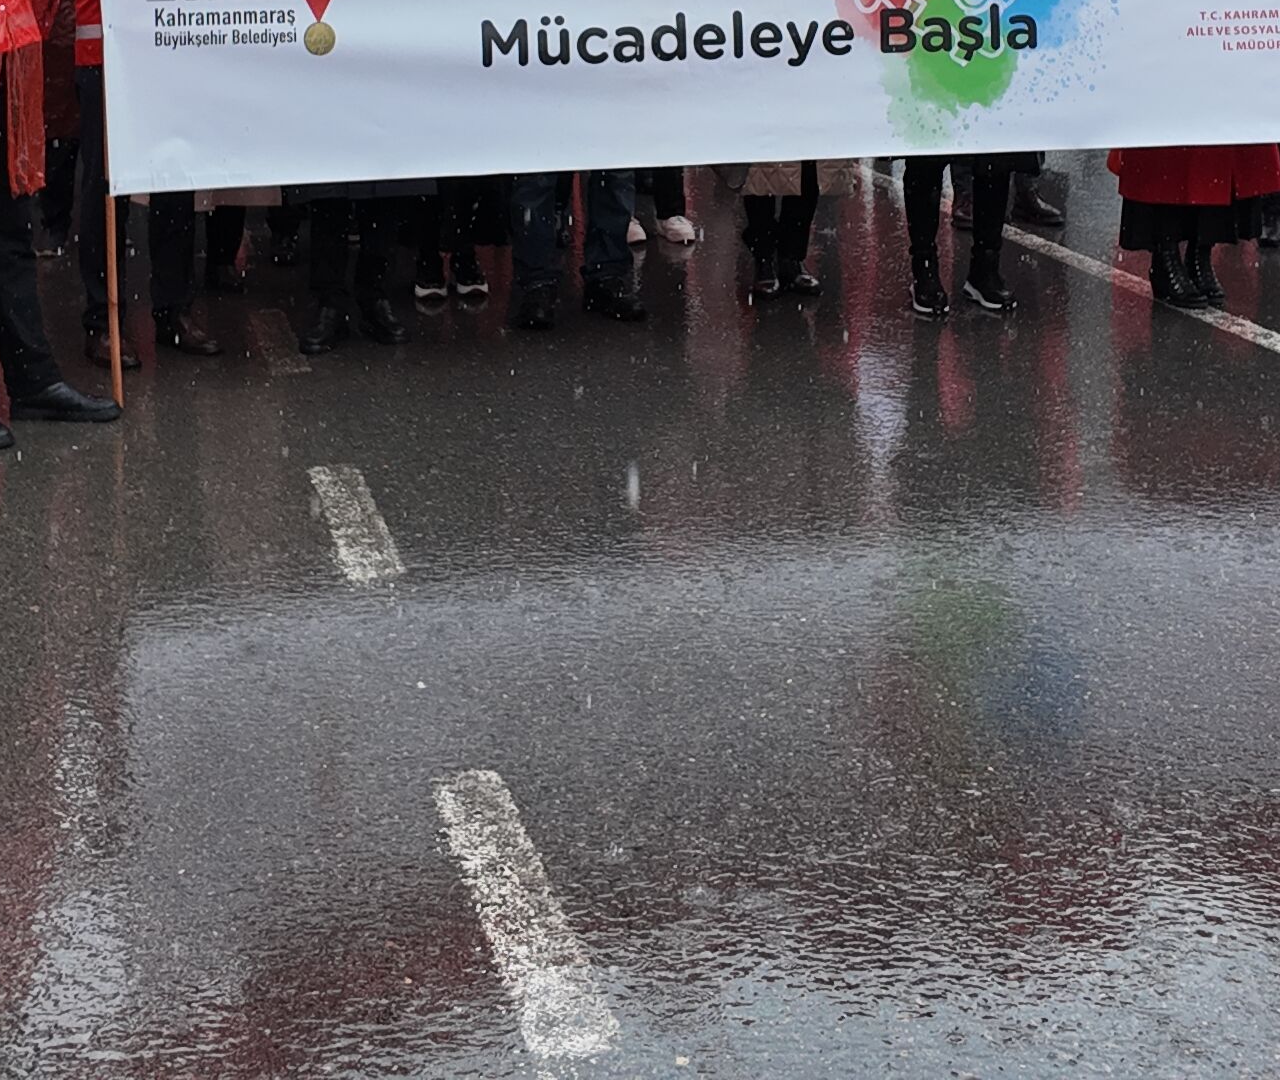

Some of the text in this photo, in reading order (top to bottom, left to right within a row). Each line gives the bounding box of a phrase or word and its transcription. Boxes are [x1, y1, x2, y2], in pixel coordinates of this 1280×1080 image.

[154, 7, 296, 27] Kahramanmaraş
[154, 27, 297, 50] Büyükşehir Belediyesi
[481, 3, 1038, 68] Mücadeleye Başla
[1186, 24, 1214, 37] AİLE
[1216, 26, 1231, 36] VE
[1222, 39, 1233, 51] İL
